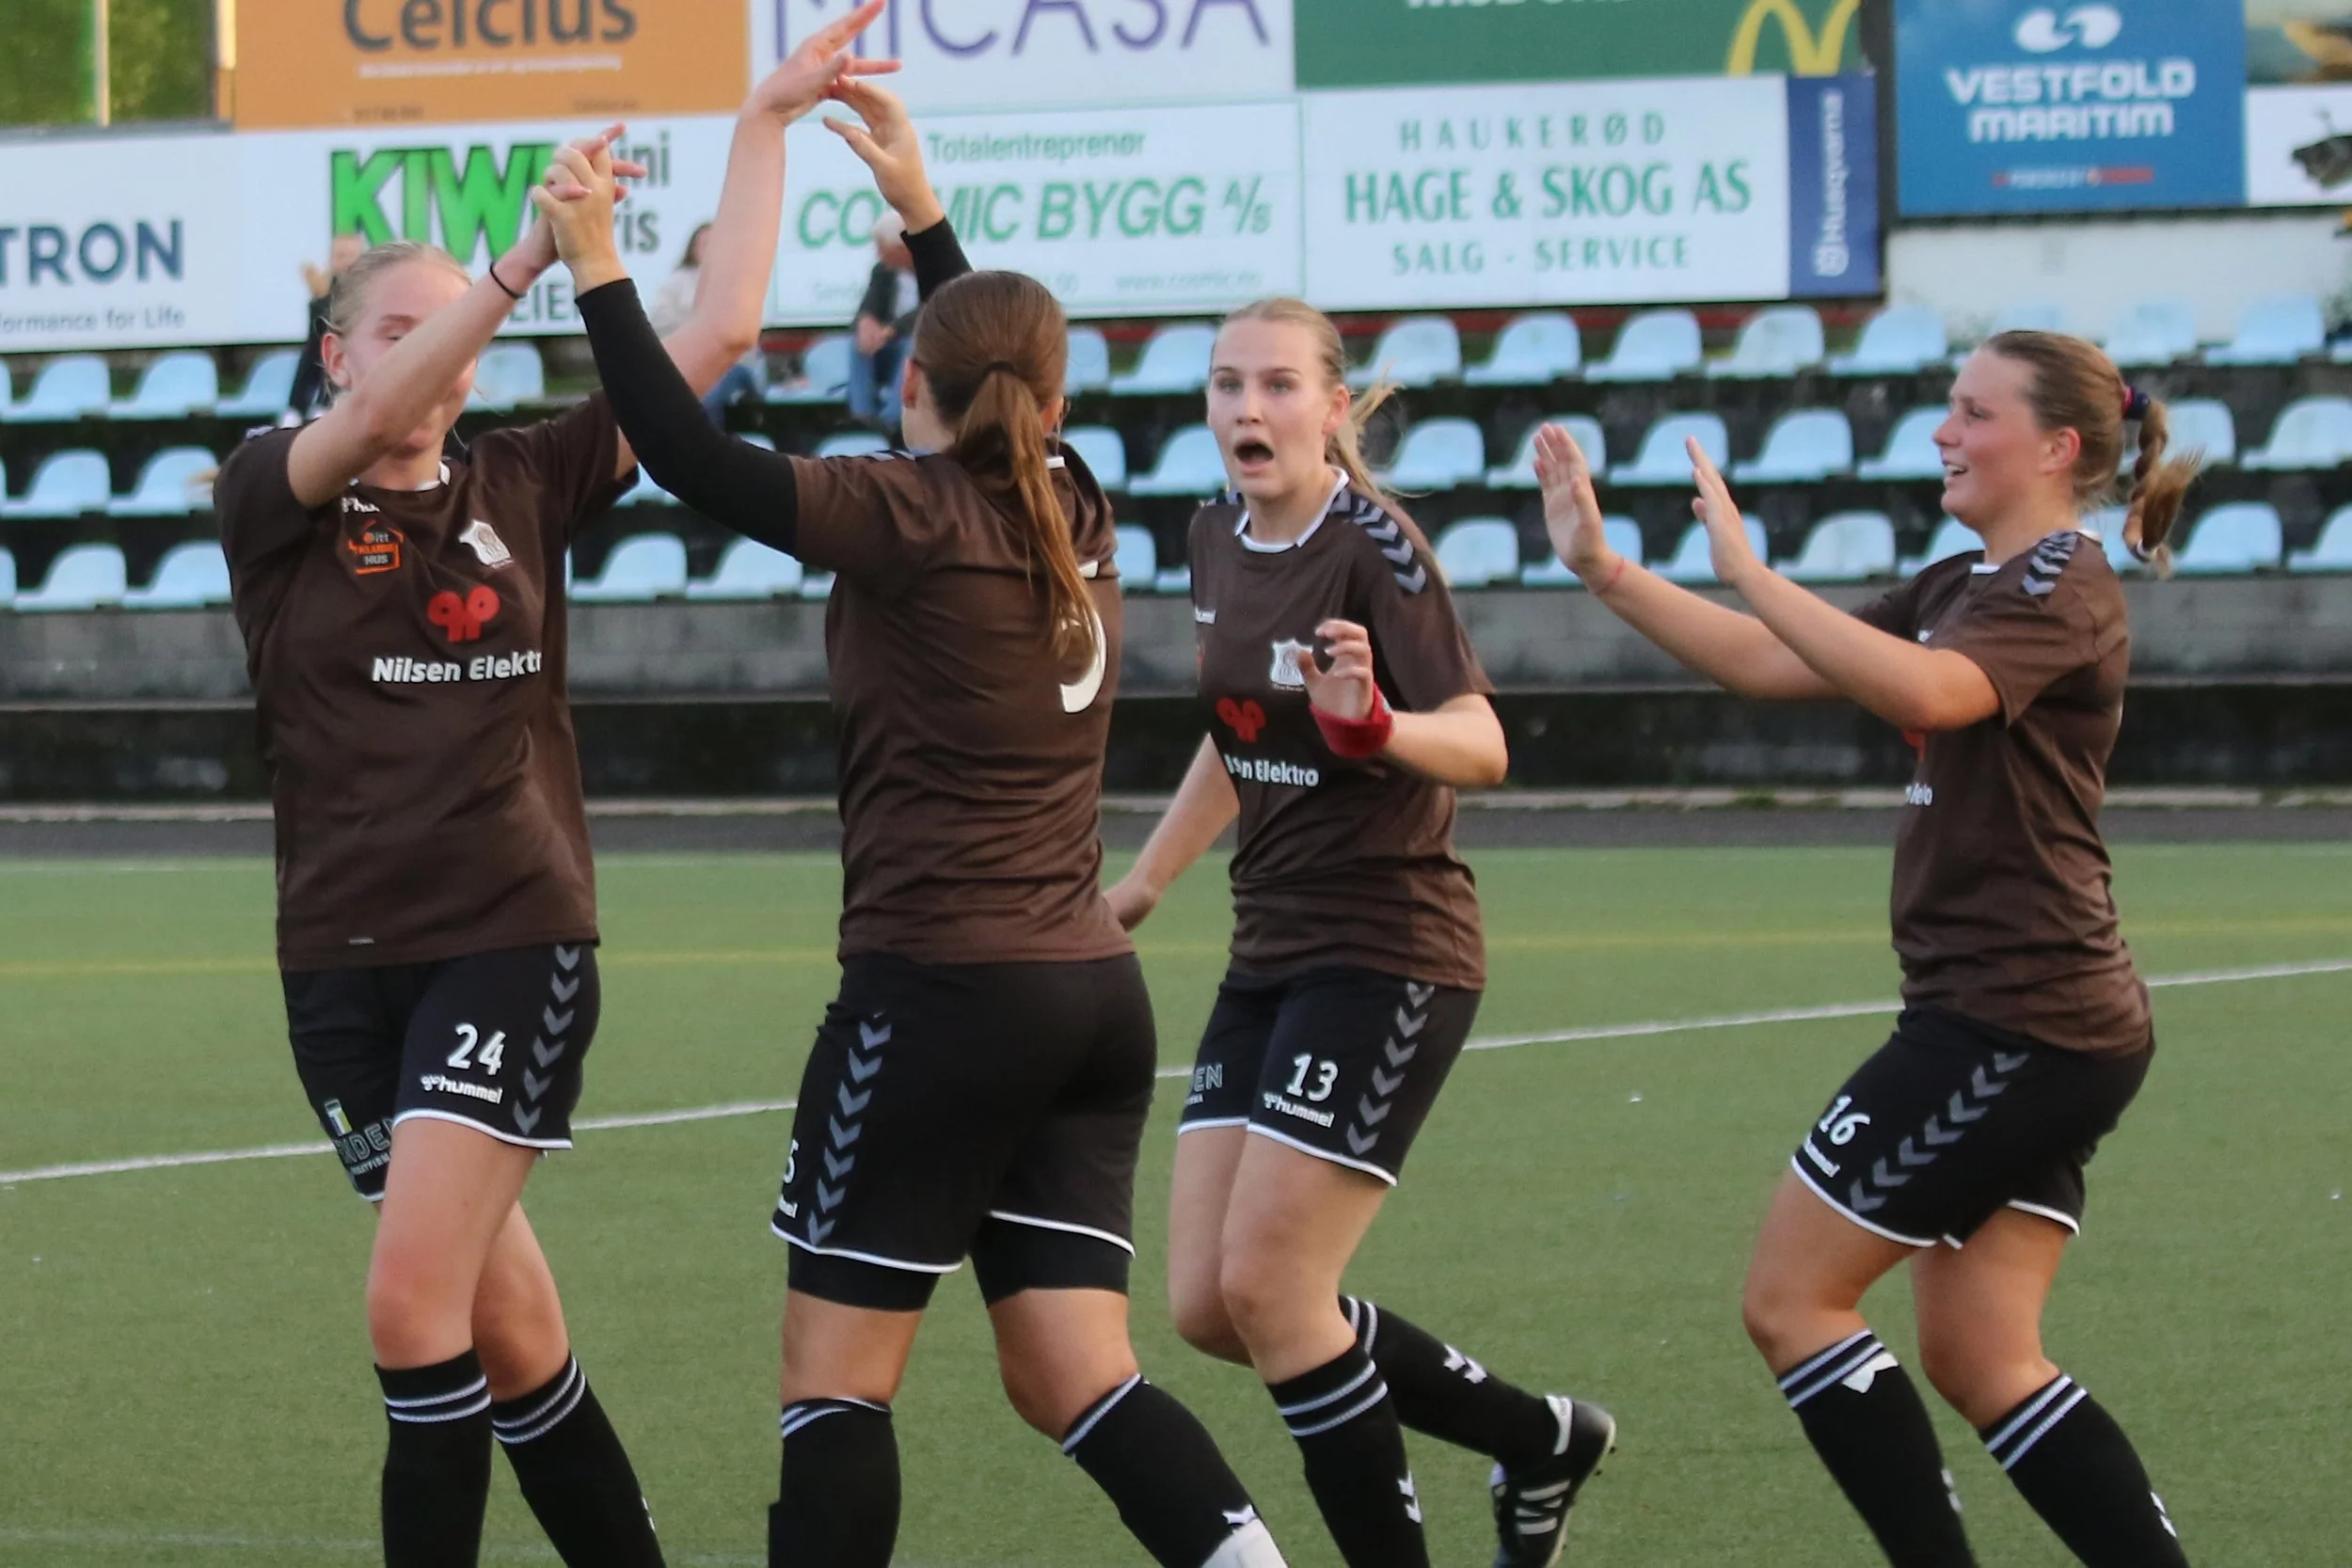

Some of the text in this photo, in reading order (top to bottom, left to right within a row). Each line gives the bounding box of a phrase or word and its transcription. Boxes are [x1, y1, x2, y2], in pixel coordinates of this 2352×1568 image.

[1944, 59, 2197, 105] VESTFOLD
[1399, 111, 1665, 151] HAUKERØD
[1969, 101, 2175, 142] MARITIM
[1343, 158, 1753, 223] HAGE & SKOG AS
[798, 183, 1025, 249] COMIC
[1037, 177, 1208, 240] BYGG
[1392, 239, 1486, 275] SALG
[1534, 233, 1692, 272] SERVICE
[372, 657, 461, 683] Nilsen
[1254, 758, 1319, 787] Elektro
[447, 1022, 507, 1075] 24
[437, 1075, 503, 1104] hummel
[1285, 1053, 1339, 1101] 13
[1275, 1095, 1335, 1128] hummel
[1818, 1094, 1871, 1147] 16
